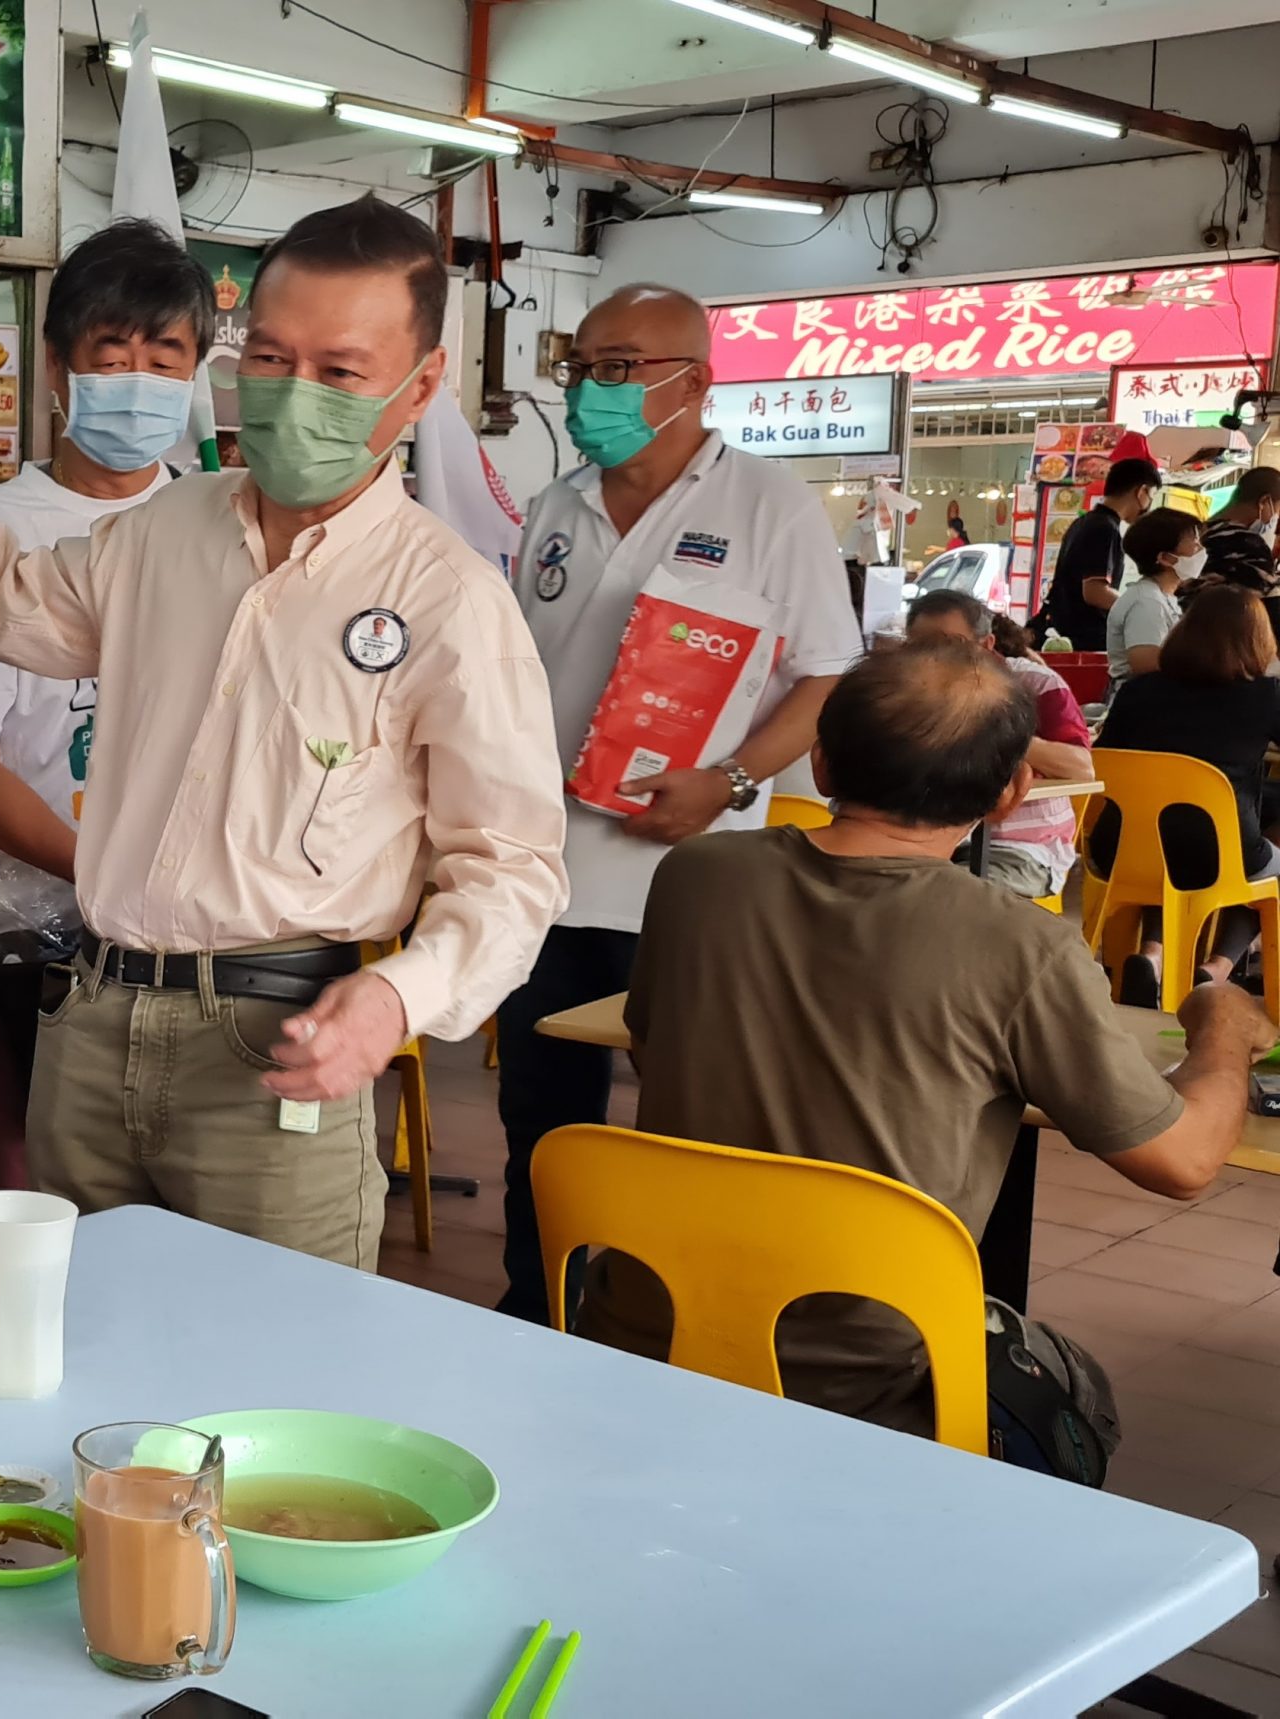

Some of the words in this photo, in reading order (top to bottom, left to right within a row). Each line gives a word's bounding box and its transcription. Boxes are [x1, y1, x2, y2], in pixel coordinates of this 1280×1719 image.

[785, 326, 987, 379] Mixed
[994, 322, 1135, 369] Rice
[748, 386, 853, 417] 肉干面包
[1142, 408, 1181, 426] Thai
[741, 425, 778, 443] Bak
[782, 424, 820, 442] Gua
[826, 422, 865, 440] Bun
[685, 628, 739, 659] eco
